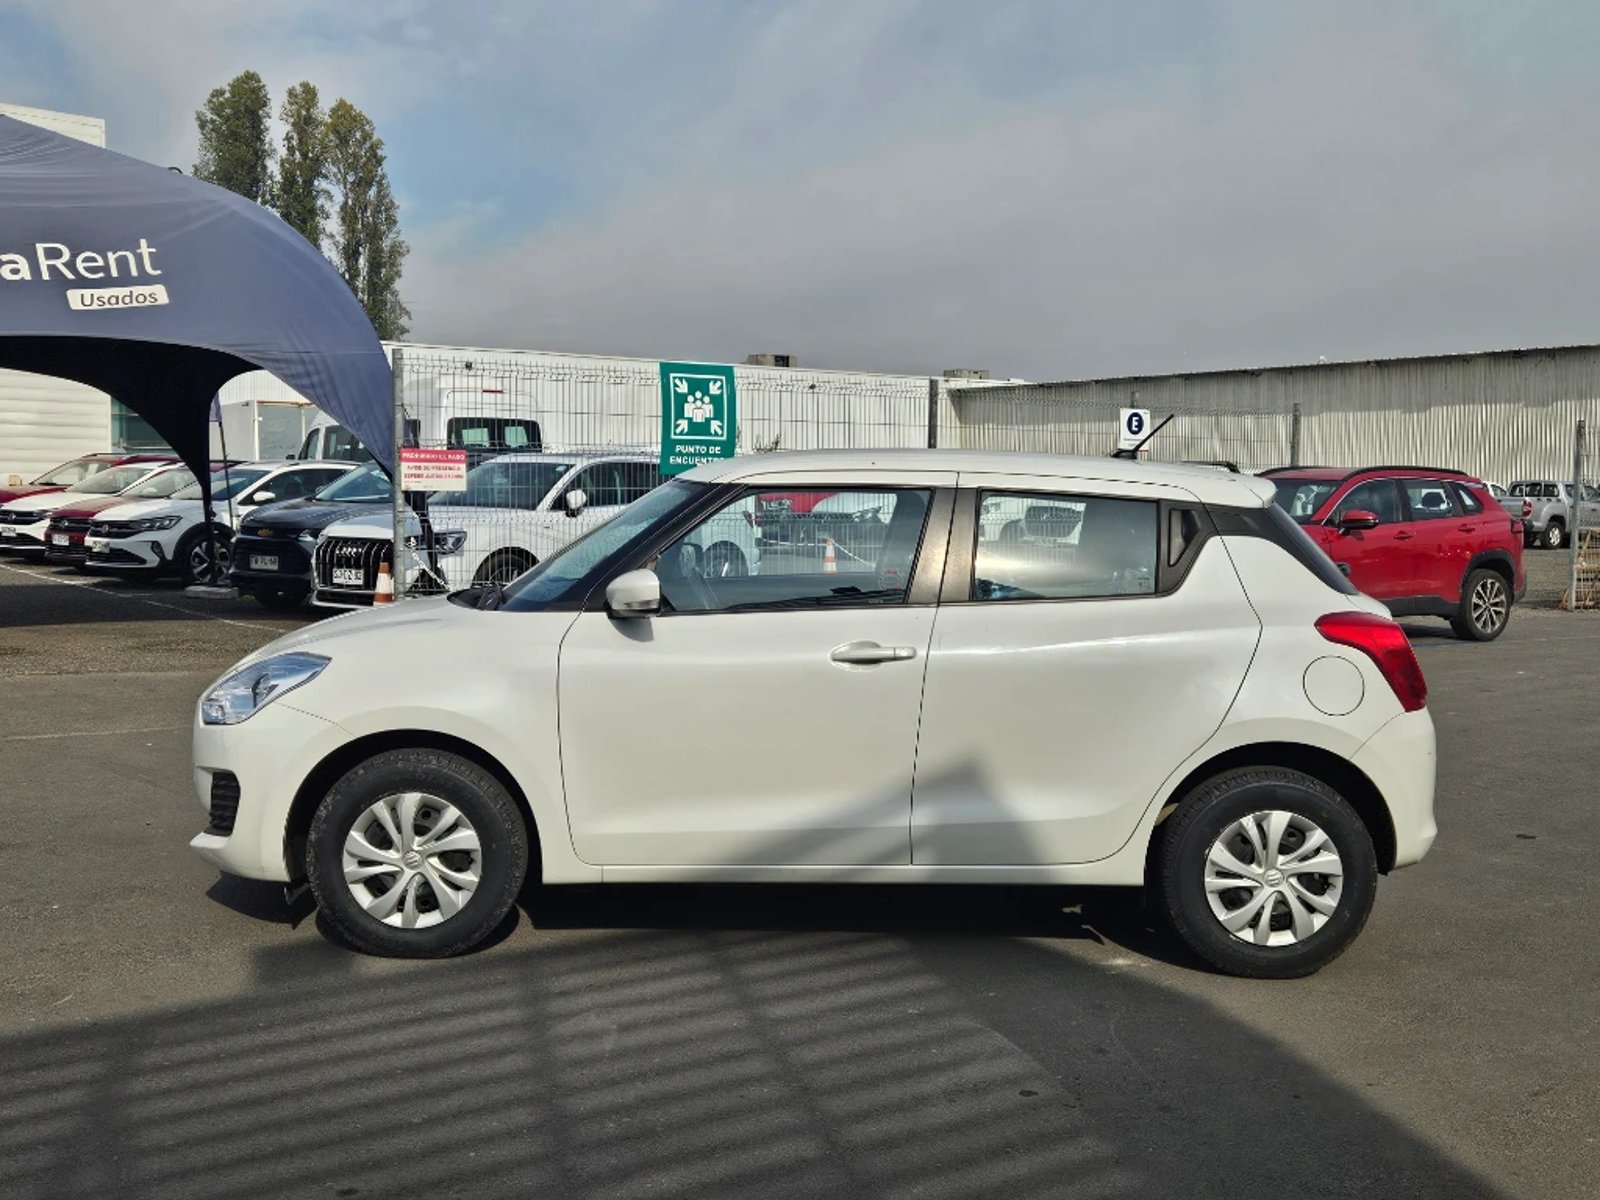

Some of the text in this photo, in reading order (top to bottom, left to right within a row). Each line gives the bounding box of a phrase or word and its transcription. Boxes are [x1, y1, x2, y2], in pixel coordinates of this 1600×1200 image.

[80, 290, 158, 307] Usados
[1132, 416, 1139, 431] E
[675, 444, 721, 454] PUNTO DE
[669, 456, 725, 465] ENCUENT
